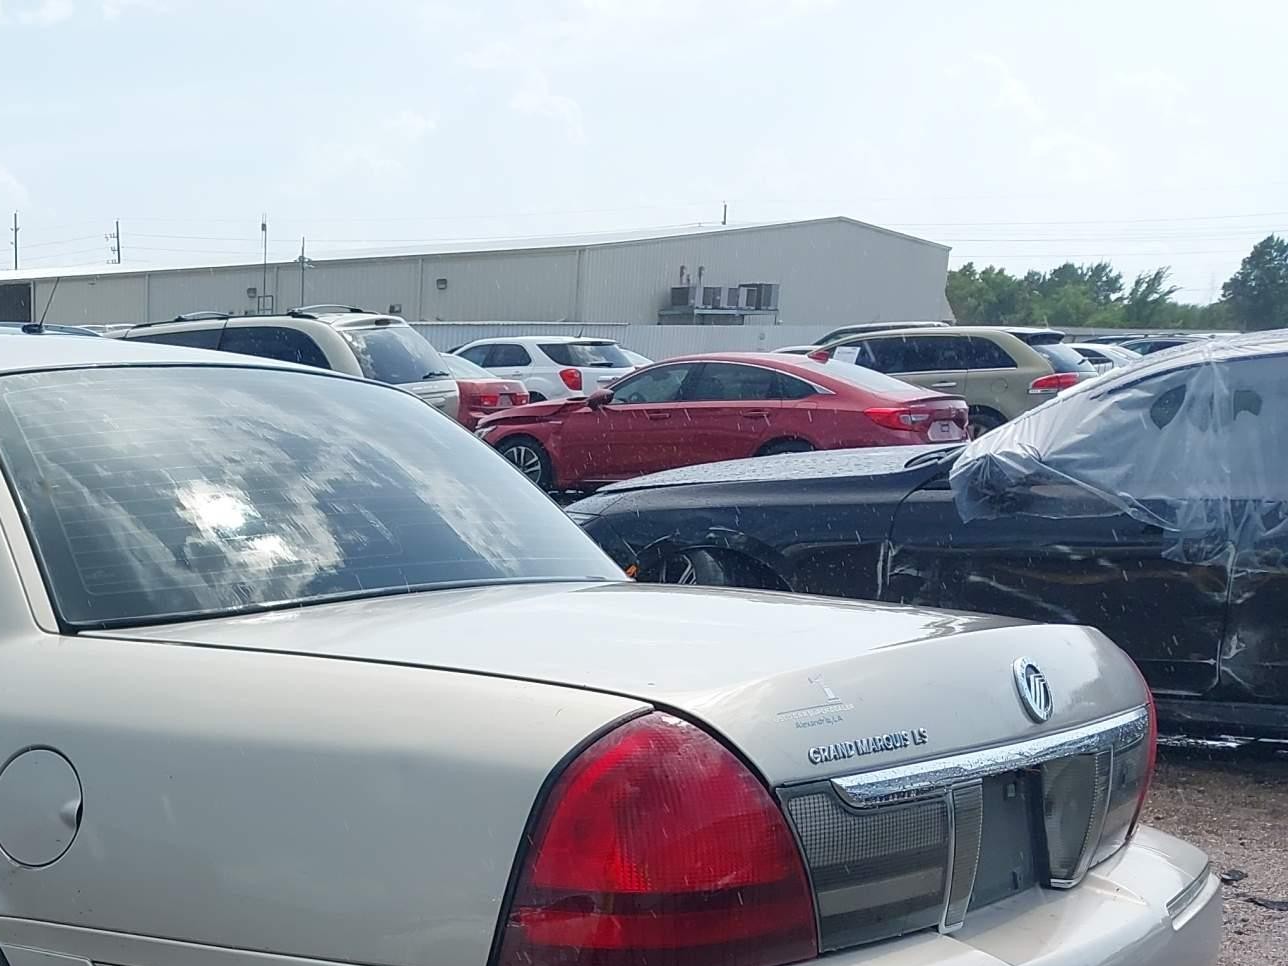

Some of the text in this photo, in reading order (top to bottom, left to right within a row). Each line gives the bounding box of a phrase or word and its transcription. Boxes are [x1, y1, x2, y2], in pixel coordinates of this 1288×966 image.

[808, 727, 929, 765] GRAND MARQUIS LS
